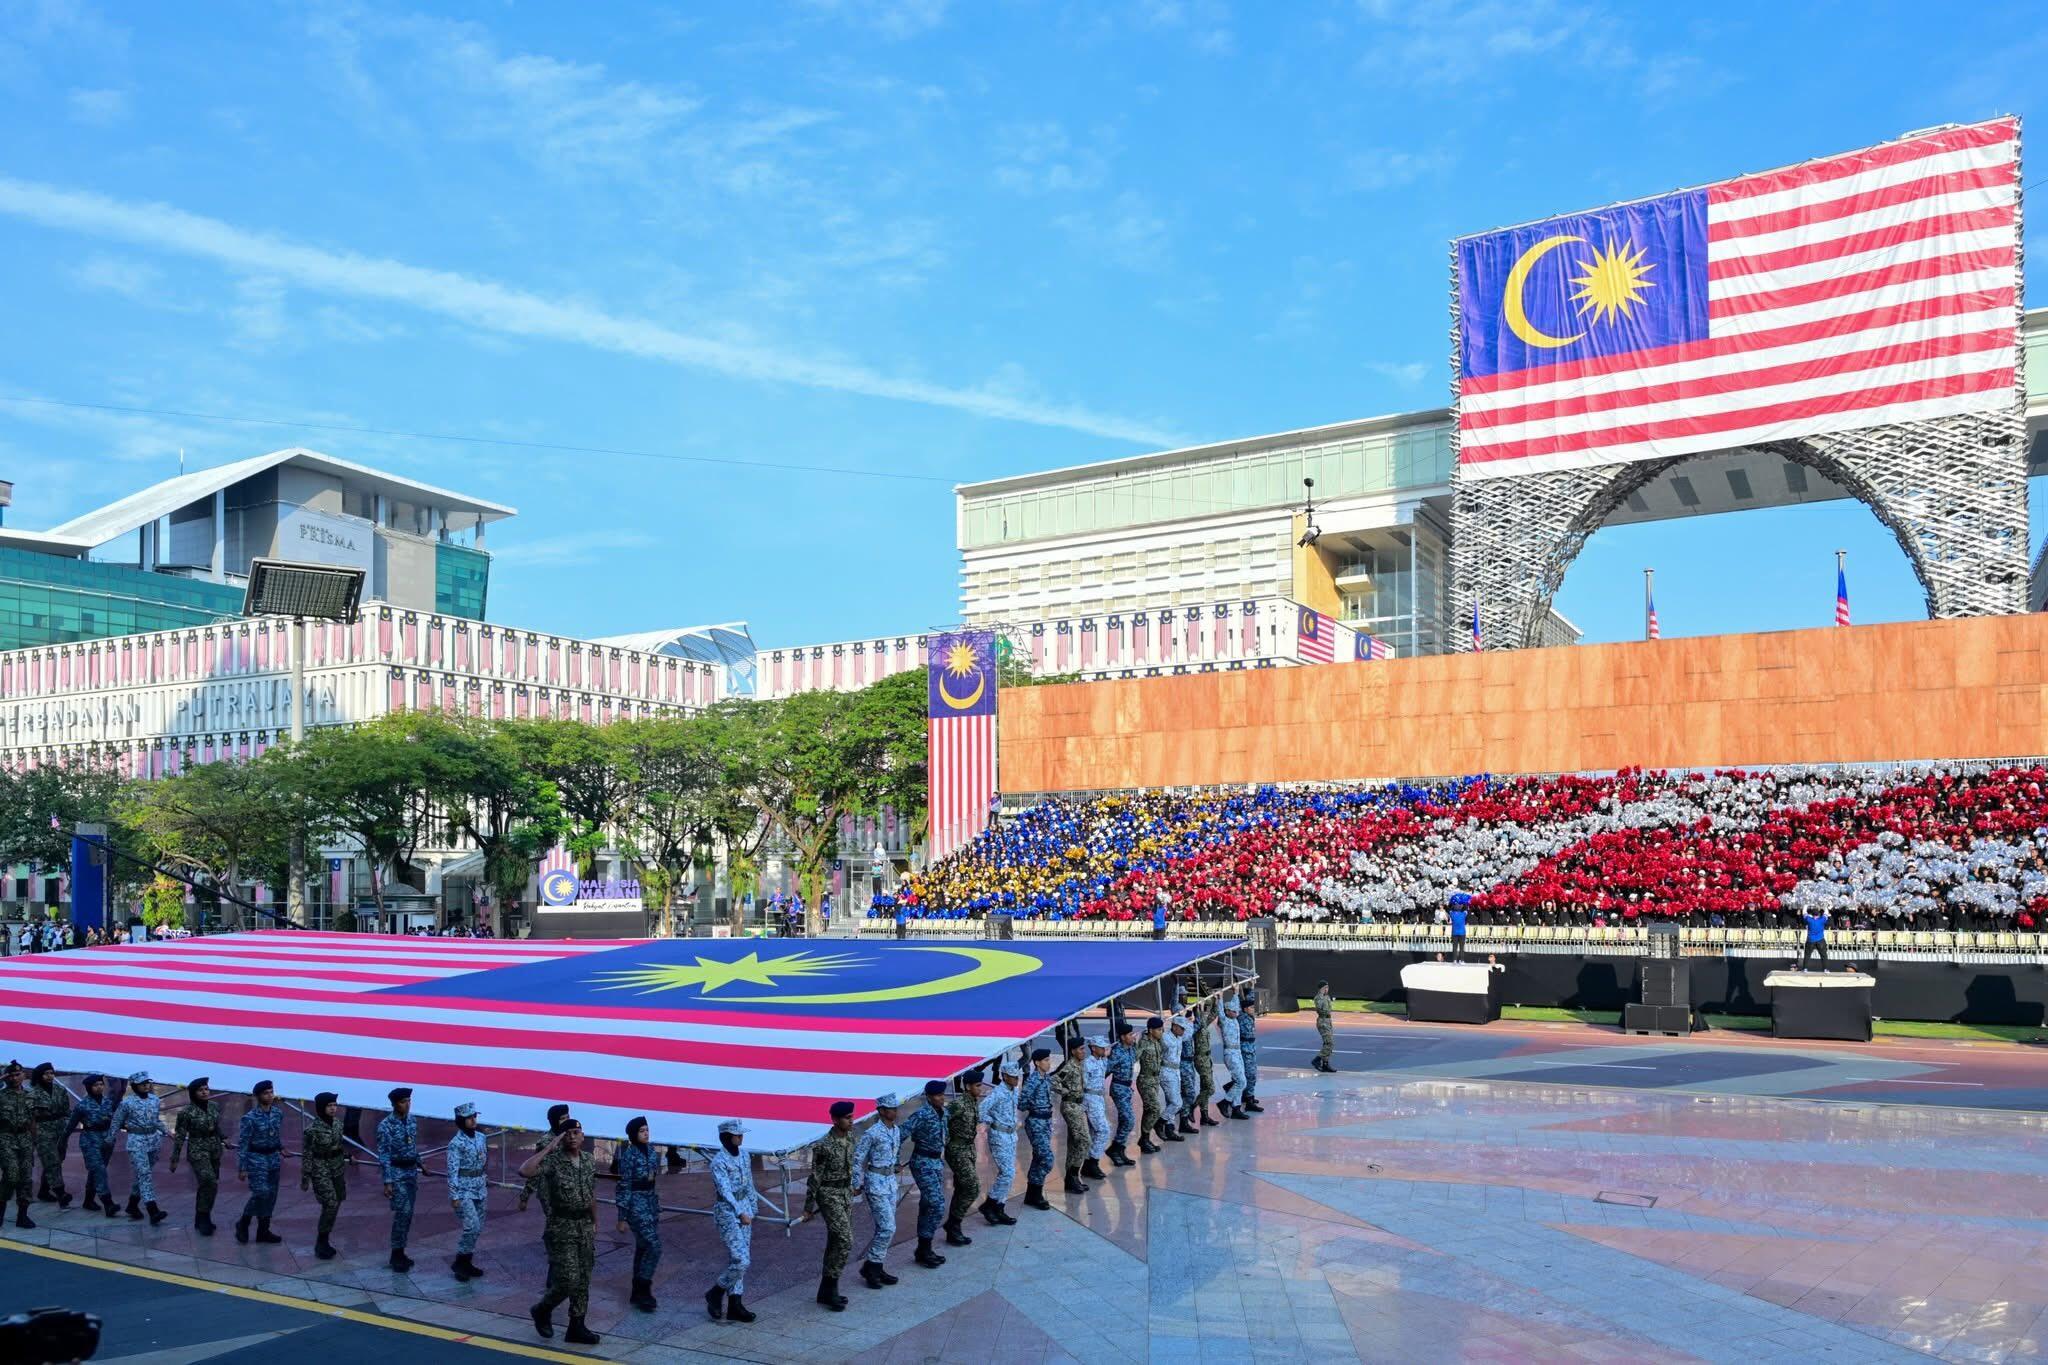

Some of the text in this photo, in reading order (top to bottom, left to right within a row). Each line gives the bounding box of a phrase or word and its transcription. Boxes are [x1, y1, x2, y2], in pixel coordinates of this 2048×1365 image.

[300, 527, 356, 551] PRISMA
[0, 686, 335, 733] ERBADANAN PUTRAJAYA
[580, 887, 640, 899] MADANI
